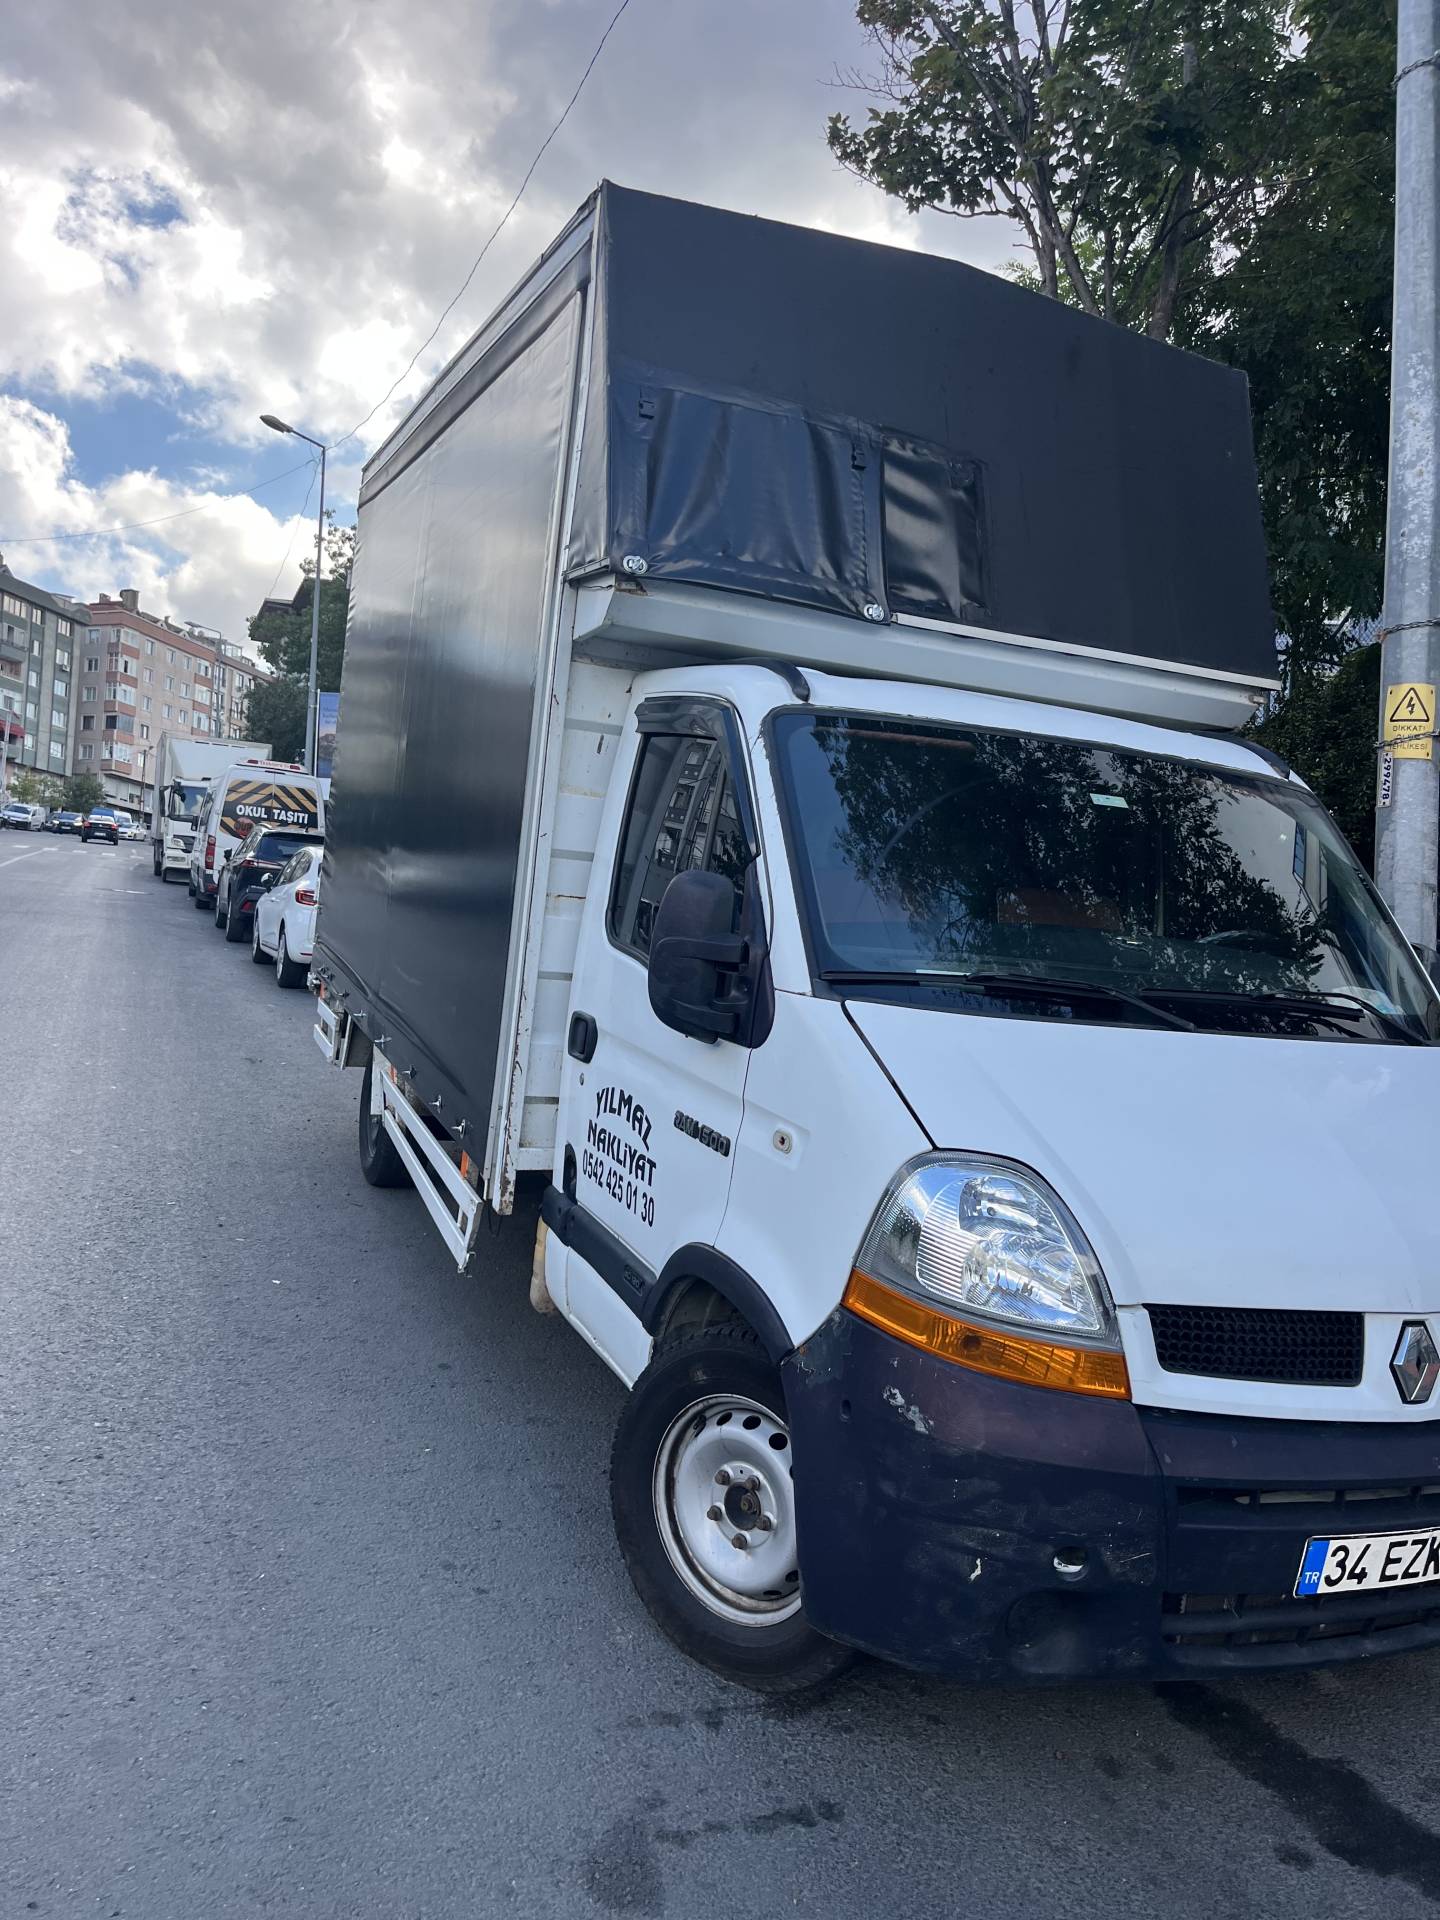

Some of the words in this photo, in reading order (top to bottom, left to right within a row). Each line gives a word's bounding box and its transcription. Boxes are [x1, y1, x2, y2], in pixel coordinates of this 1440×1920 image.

[1382, 757, 1392, 800] 299478
[236, 804, 268, 818] OKUL
[272, 809, 309, 824] TAŞITI
[596, 1087, 652, 1151] YILMAZ
[582, 1148, 605, 1189] 0542
[606, 1166, 623, 1203] 425
[626, 1180, 639, 1215] 01
[641, 1192, 655, 1228] 30
[1304, 1571, 1320, 1584] TR
[1324, 1544, 1372, 1588] 34
